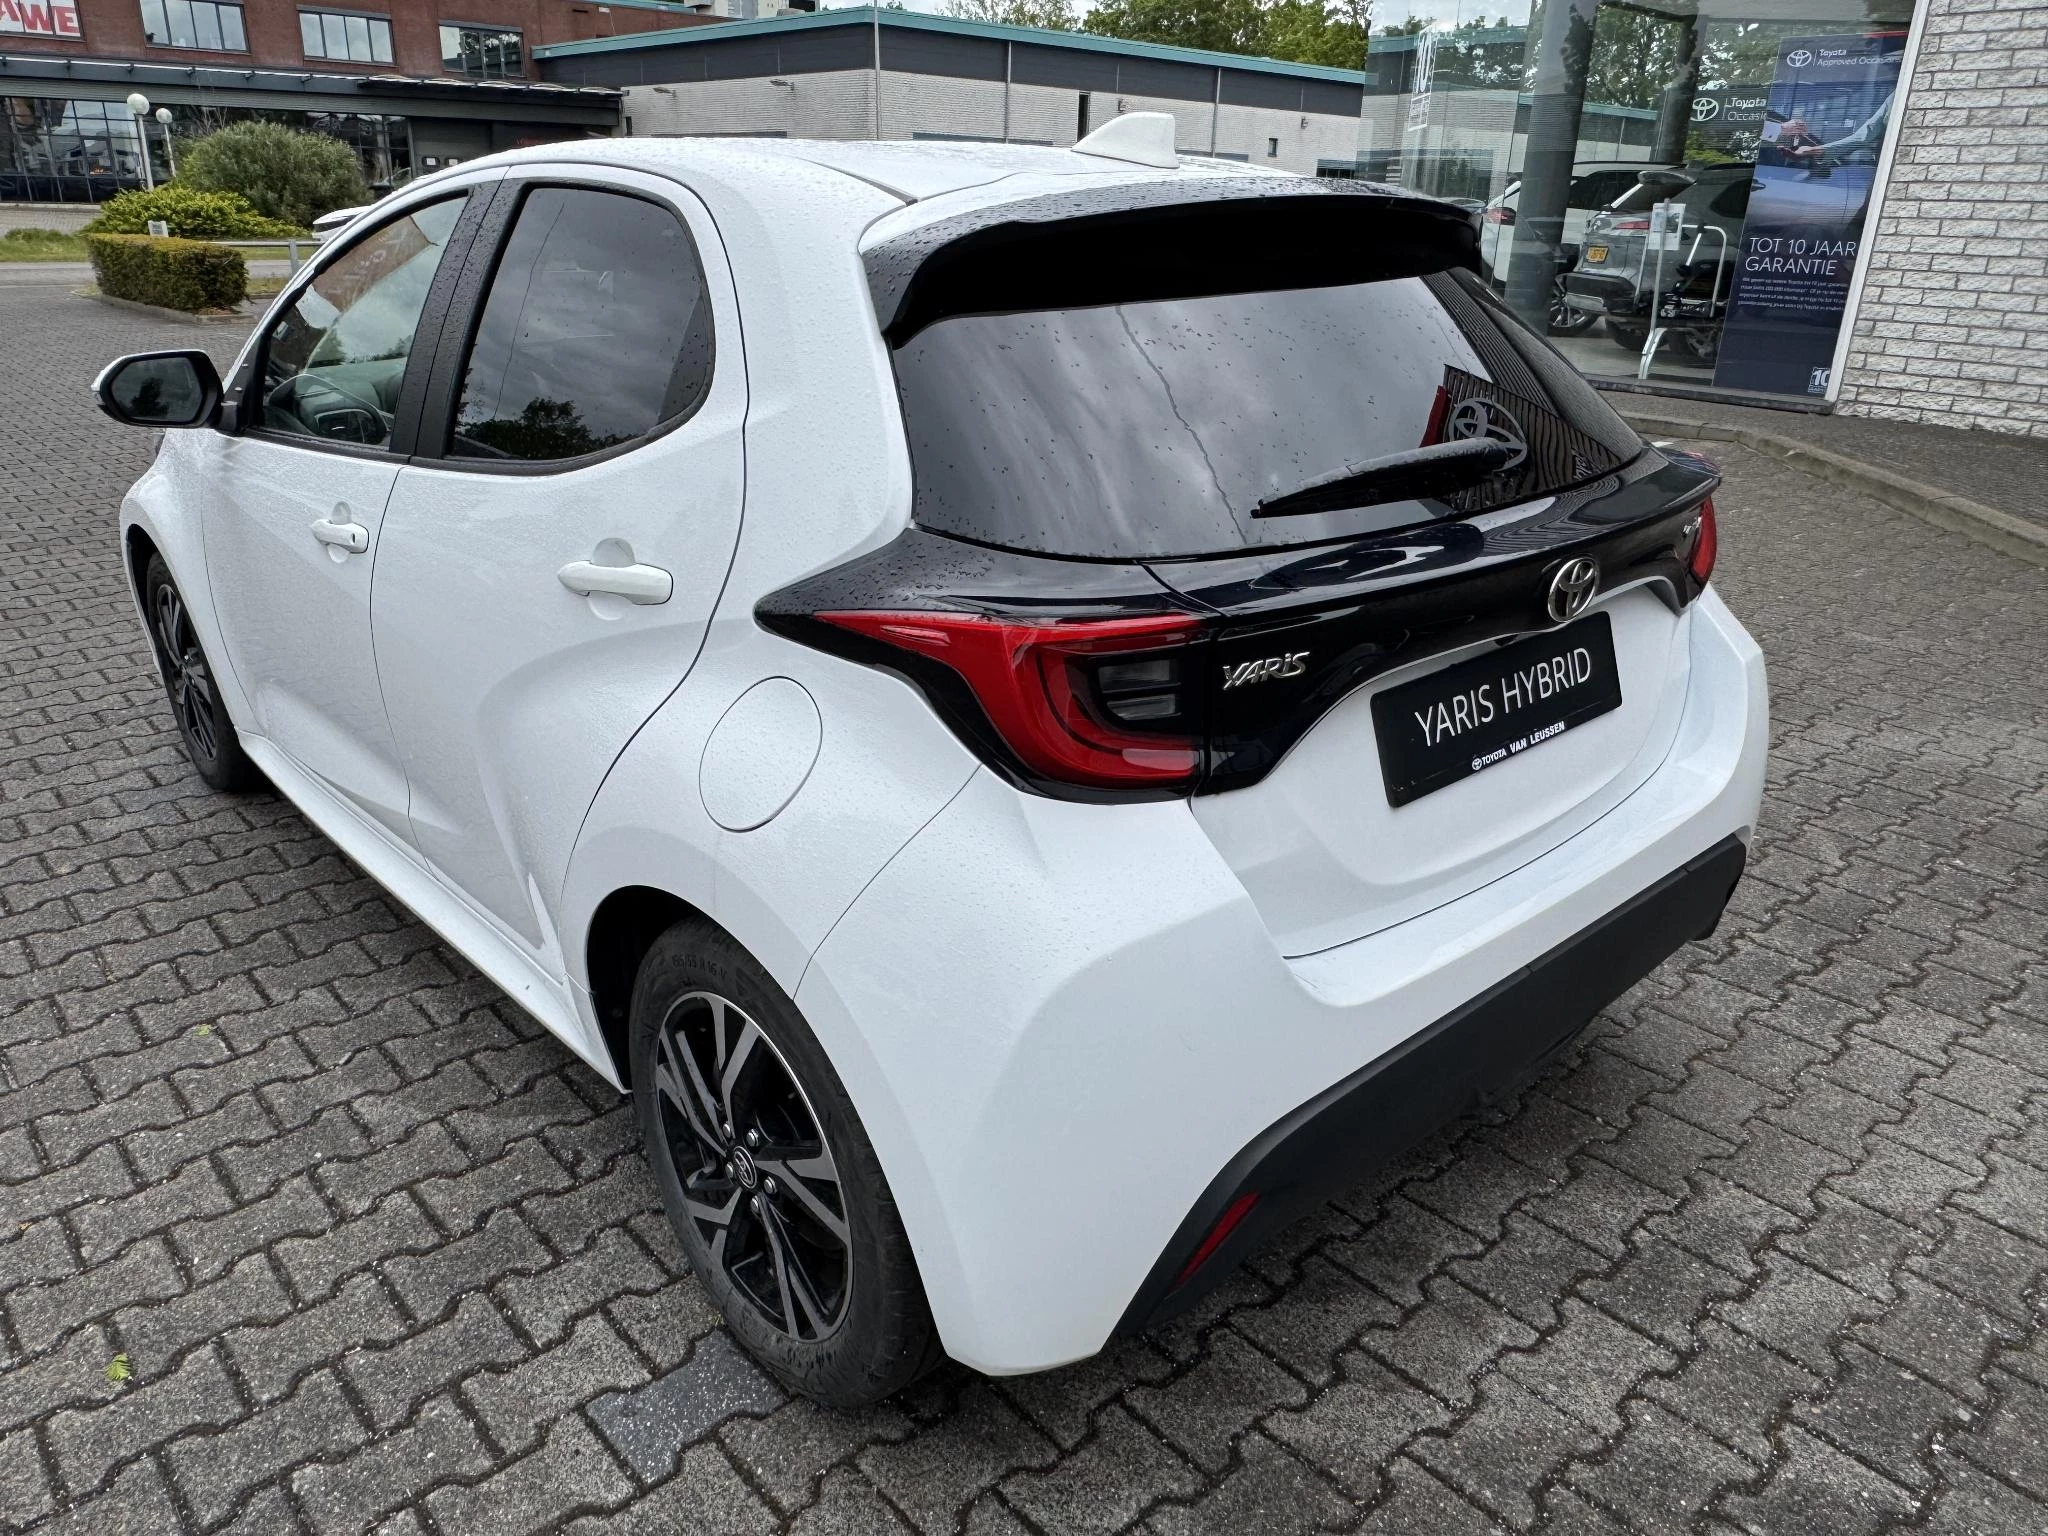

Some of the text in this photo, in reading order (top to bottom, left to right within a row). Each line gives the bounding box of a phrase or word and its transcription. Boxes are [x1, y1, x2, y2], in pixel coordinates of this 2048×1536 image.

[1817, 57, 1857, 67] Approved
[1820, 48, 1847, 58] Toyota
[1730, 97, 1767, 110] Toyota
[1750, 237, 1857, 257] TOT 10 JAAR
[1745, 256, 1838, 276] GARANTIE
[1414, 647, 1592, 747] YARIS HYBRID
[1481, 720, 1566, 766] TOYOTA VAN LEUSSEN
